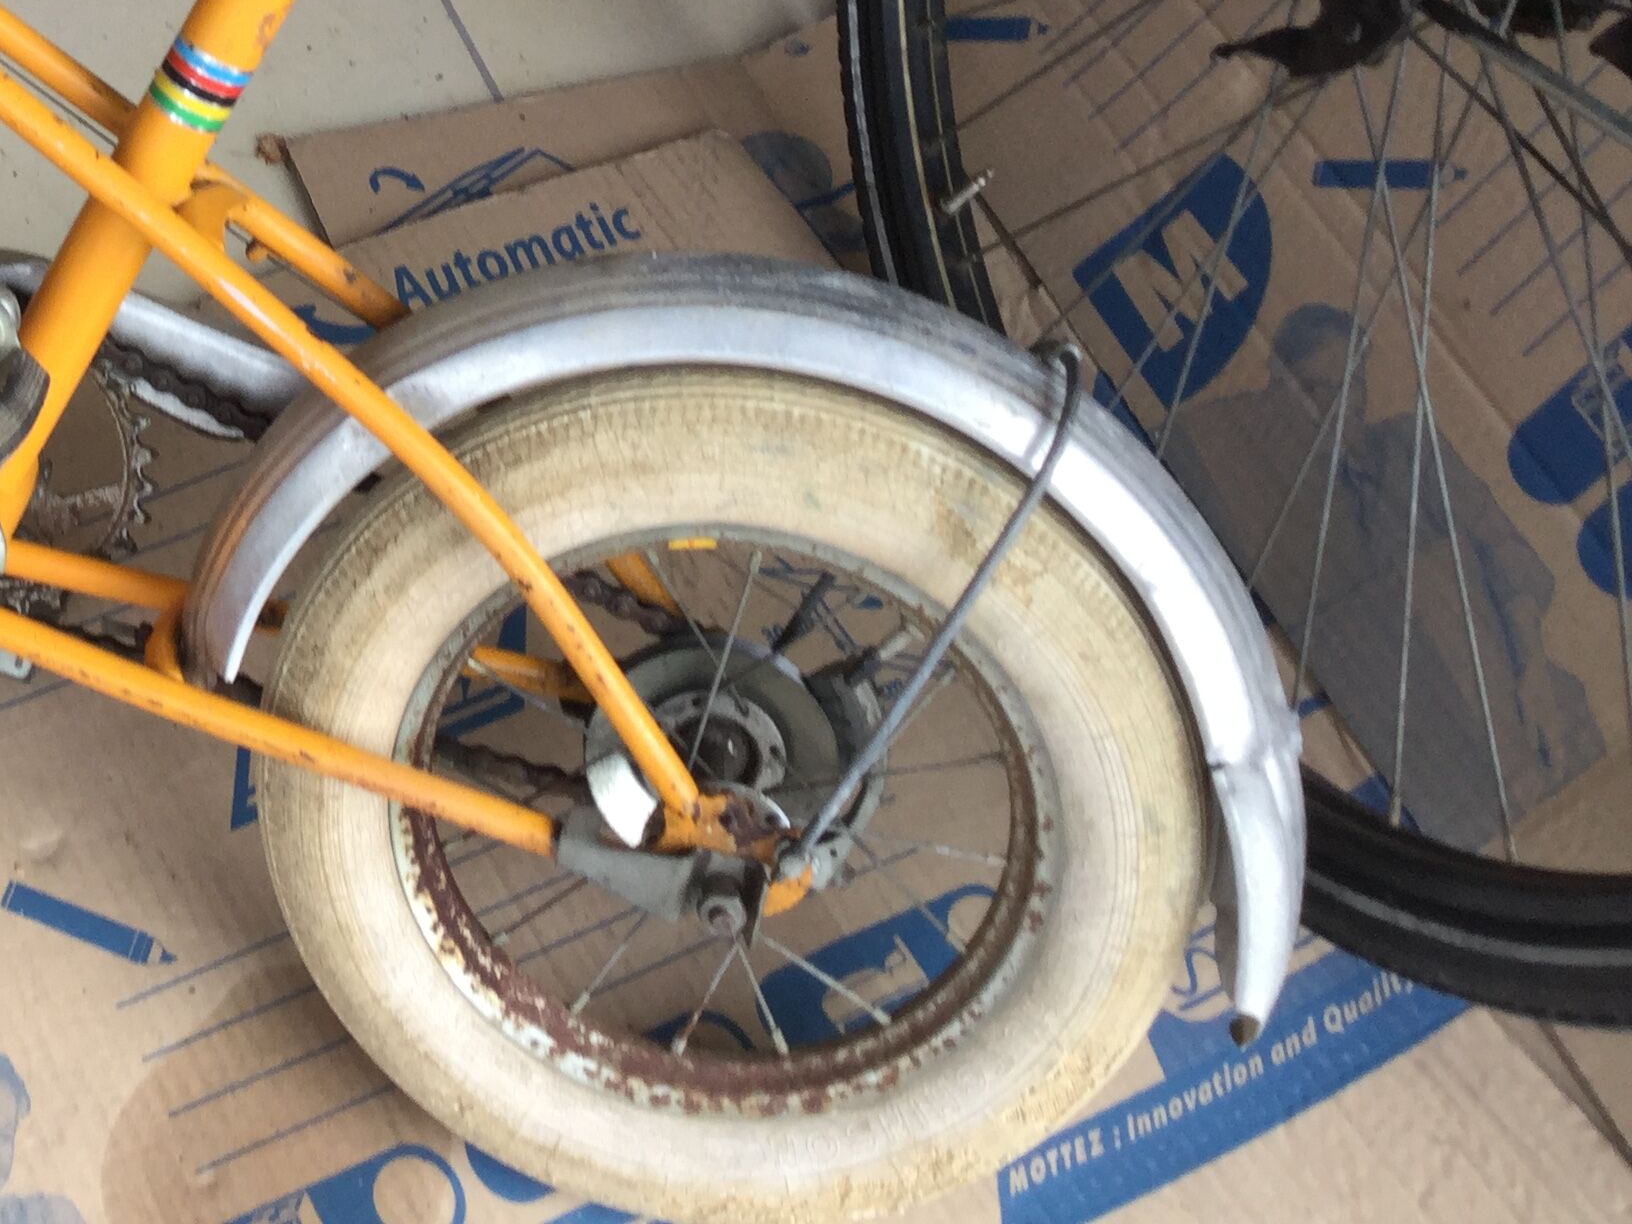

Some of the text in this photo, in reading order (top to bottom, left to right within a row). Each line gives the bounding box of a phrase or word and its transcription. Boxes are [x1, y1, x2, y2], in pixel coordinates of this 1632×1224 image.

[393, 201, 642, 311] Automatic
[1110, 208, 1250, 353] M
[1008, 1126, 1106, 1198] MOTTEZ
[1127, 1052, 1265, 1144] Innovation
[1270, 1015, 1318, 1067] and
